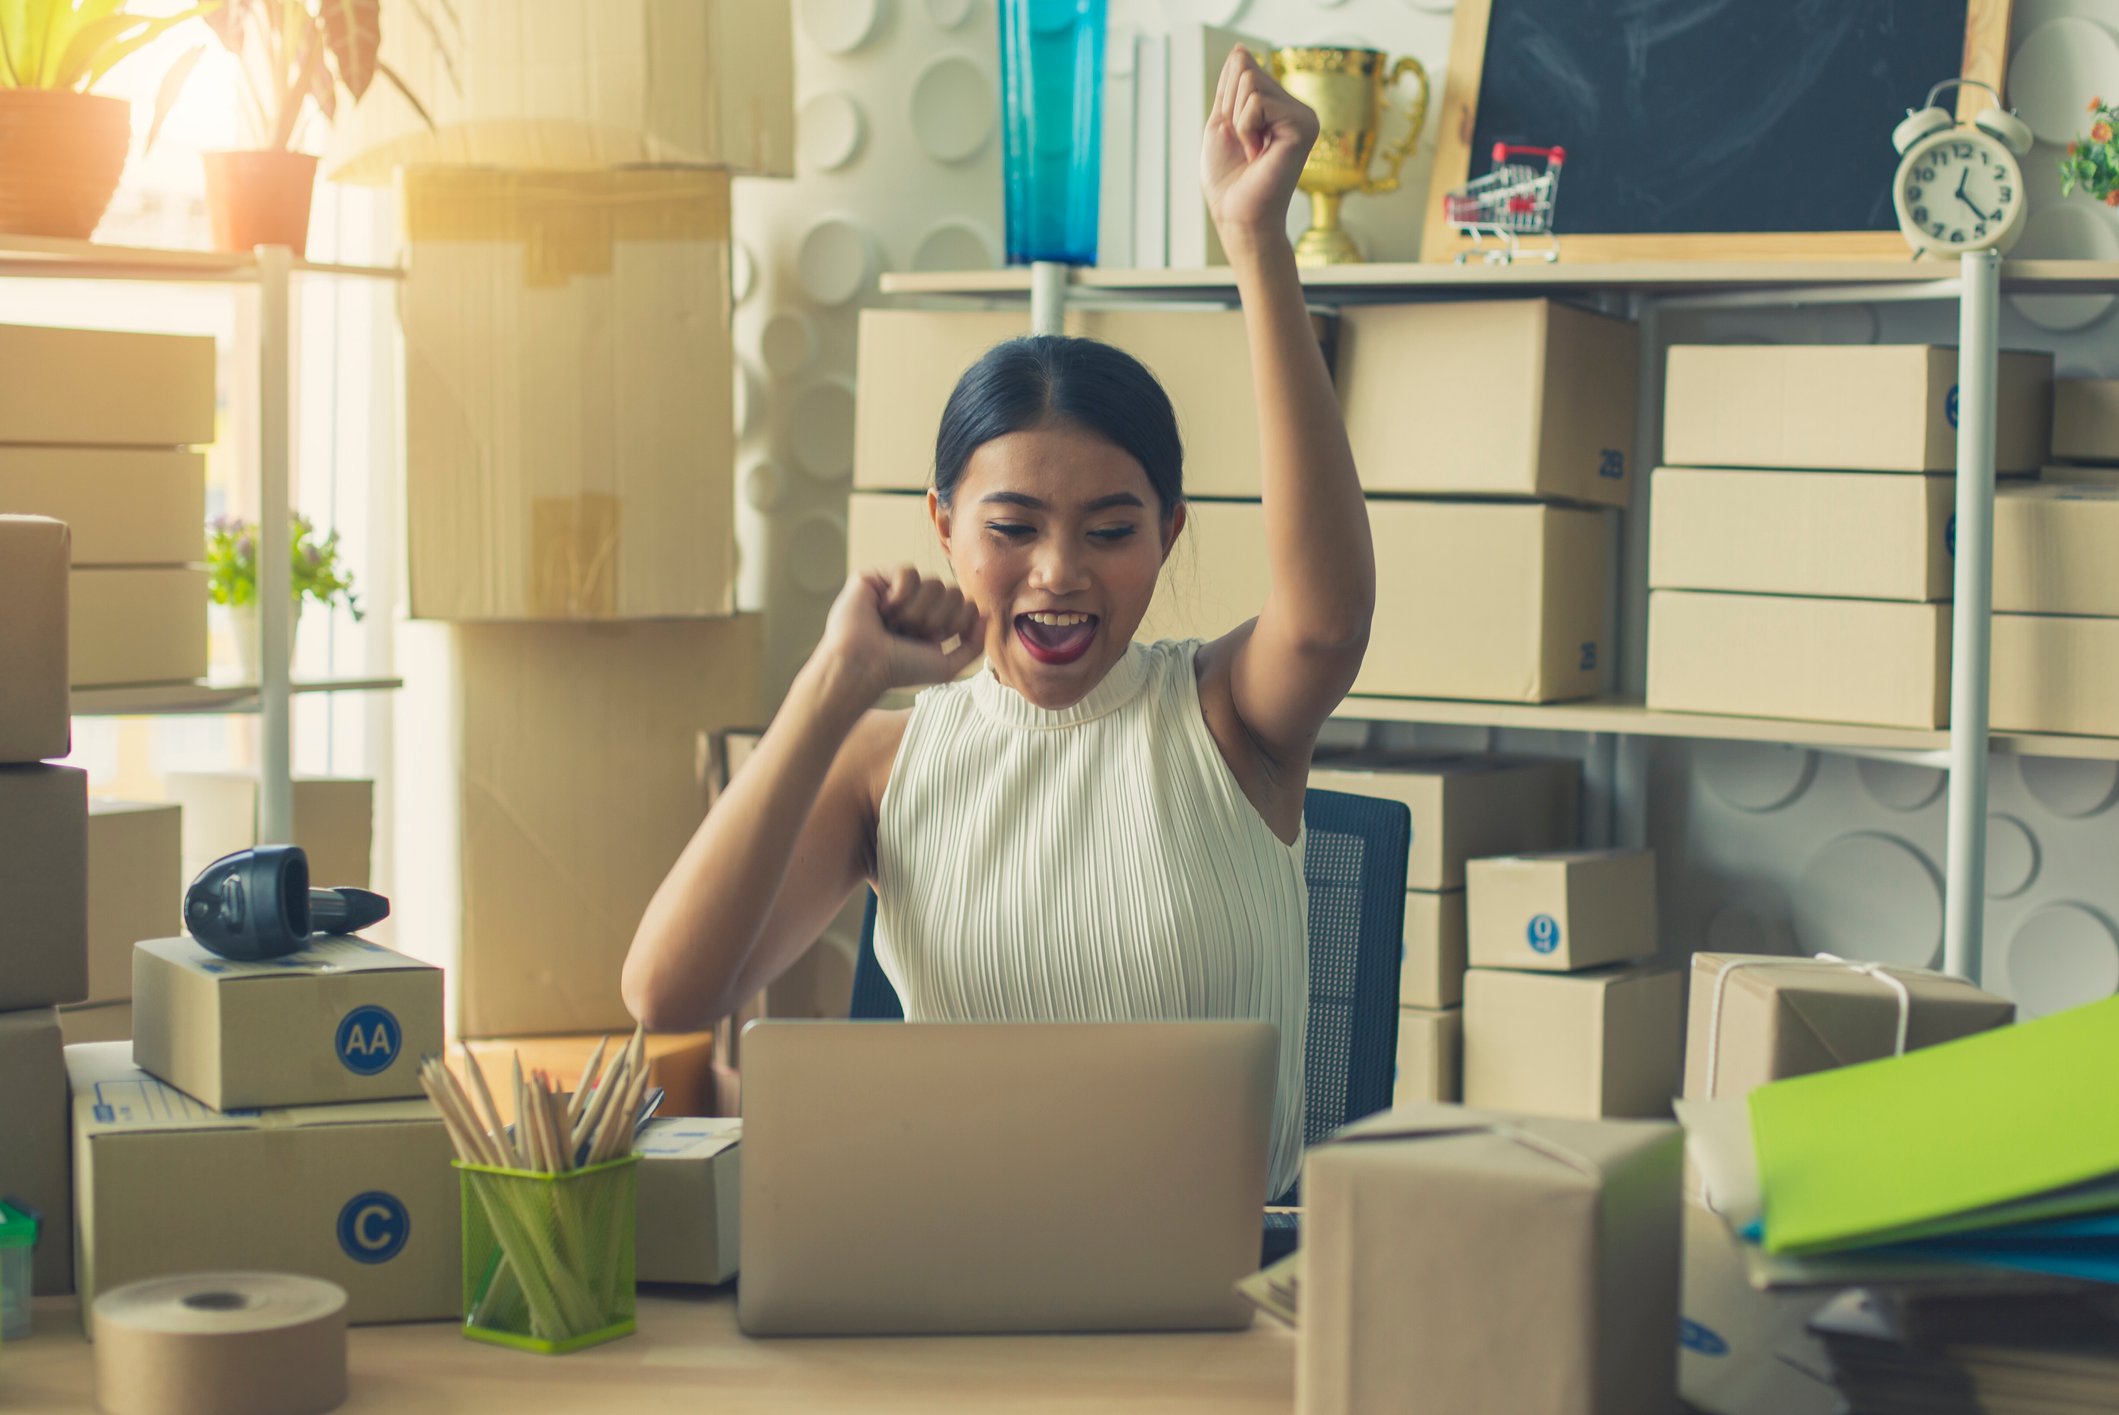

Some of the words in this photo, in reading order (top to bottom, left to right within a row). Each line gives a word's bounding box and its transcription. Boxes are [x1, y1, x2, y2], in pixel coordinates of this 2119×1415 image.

[1930, 151, 1948, 165] 11
[1952, 143, 1974, 159] 12
[1981, 152, 1988, 165] 1
[1913, 167, 1935, 182] 10
[1994, 164, 2006, 180] 2
[1908, 186, 1922, 202] 9
[1999, 186, 2012, 203] 3
[1913, 206, 1928, 224] 8
[1989, 208, 2003, 222] 4
[1932, 222, 1946, 238] 7
[1950, 231, 1965, 243] 6
[1974, 223, 1987, 239] 5
[344, 1022, 391, 1055] AA
[354, 1205, 392, 1250] C
